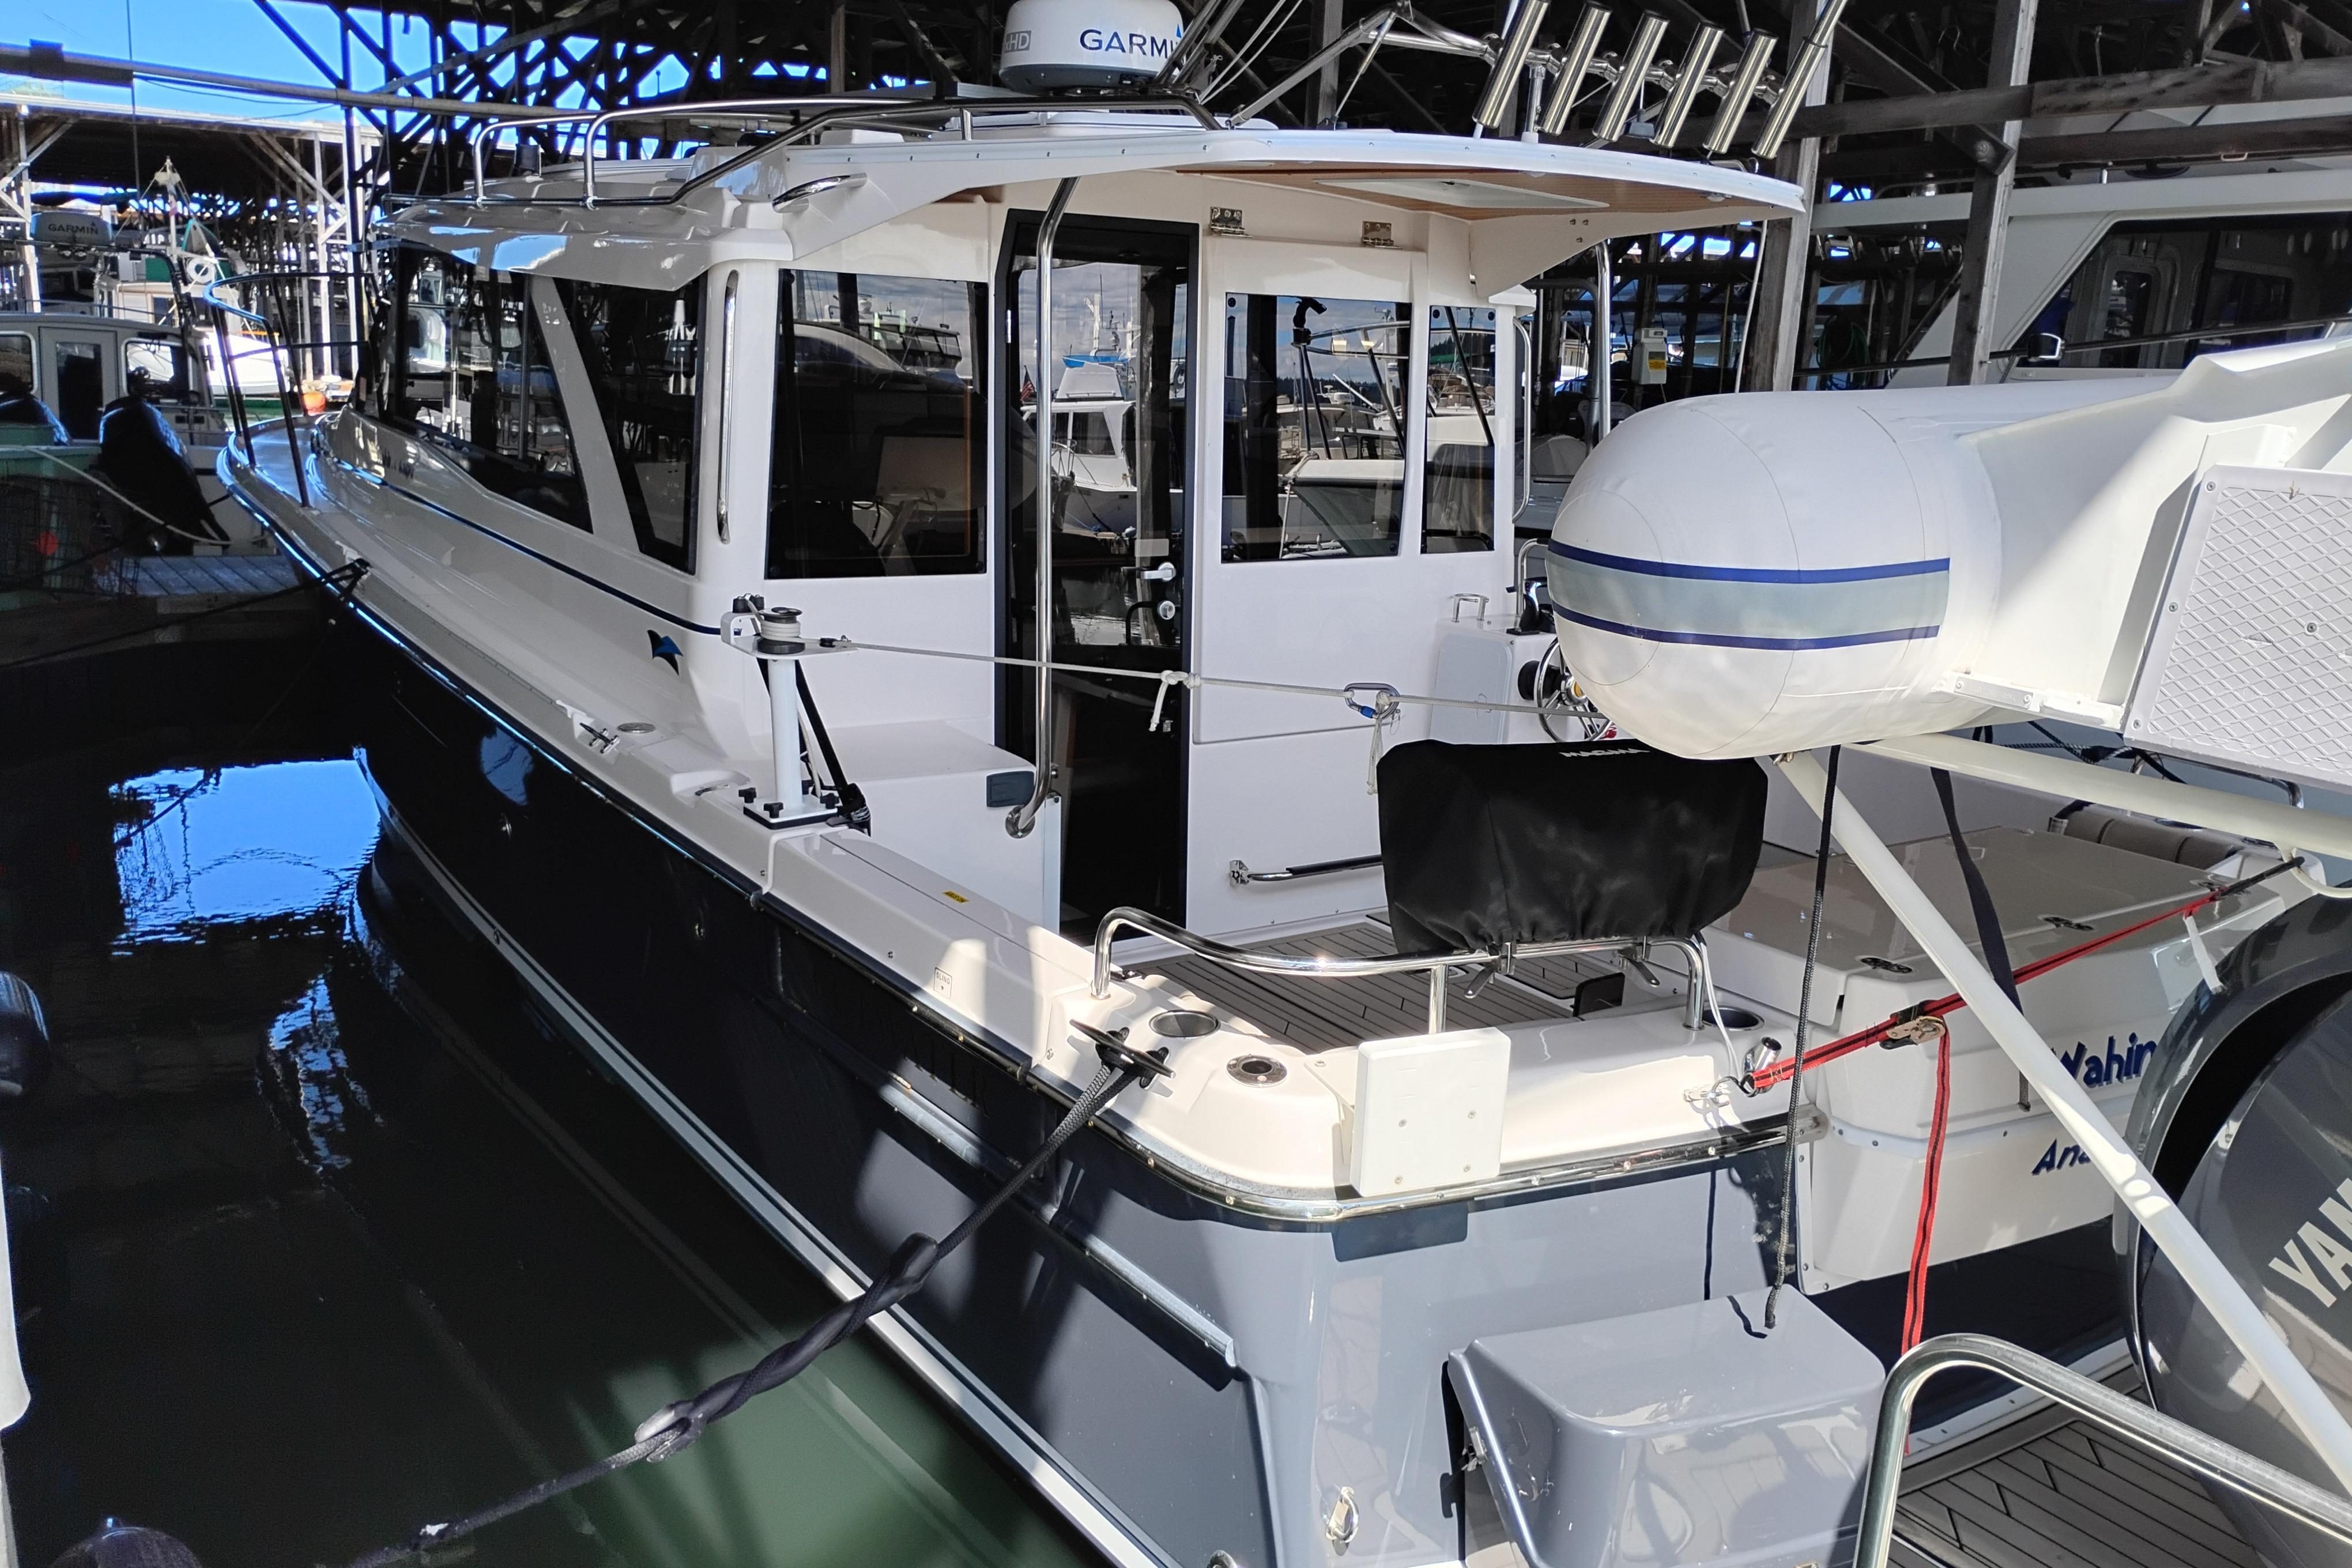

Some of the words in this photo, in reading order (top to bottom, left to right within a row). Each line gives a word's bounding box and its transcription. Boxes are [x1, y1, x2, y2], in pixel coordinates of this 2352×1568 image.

[1080, 29, 1178, 59] GARMI
[48, 223, 99, 235] GARMIN
[936, 972, 950, 985] SLING
